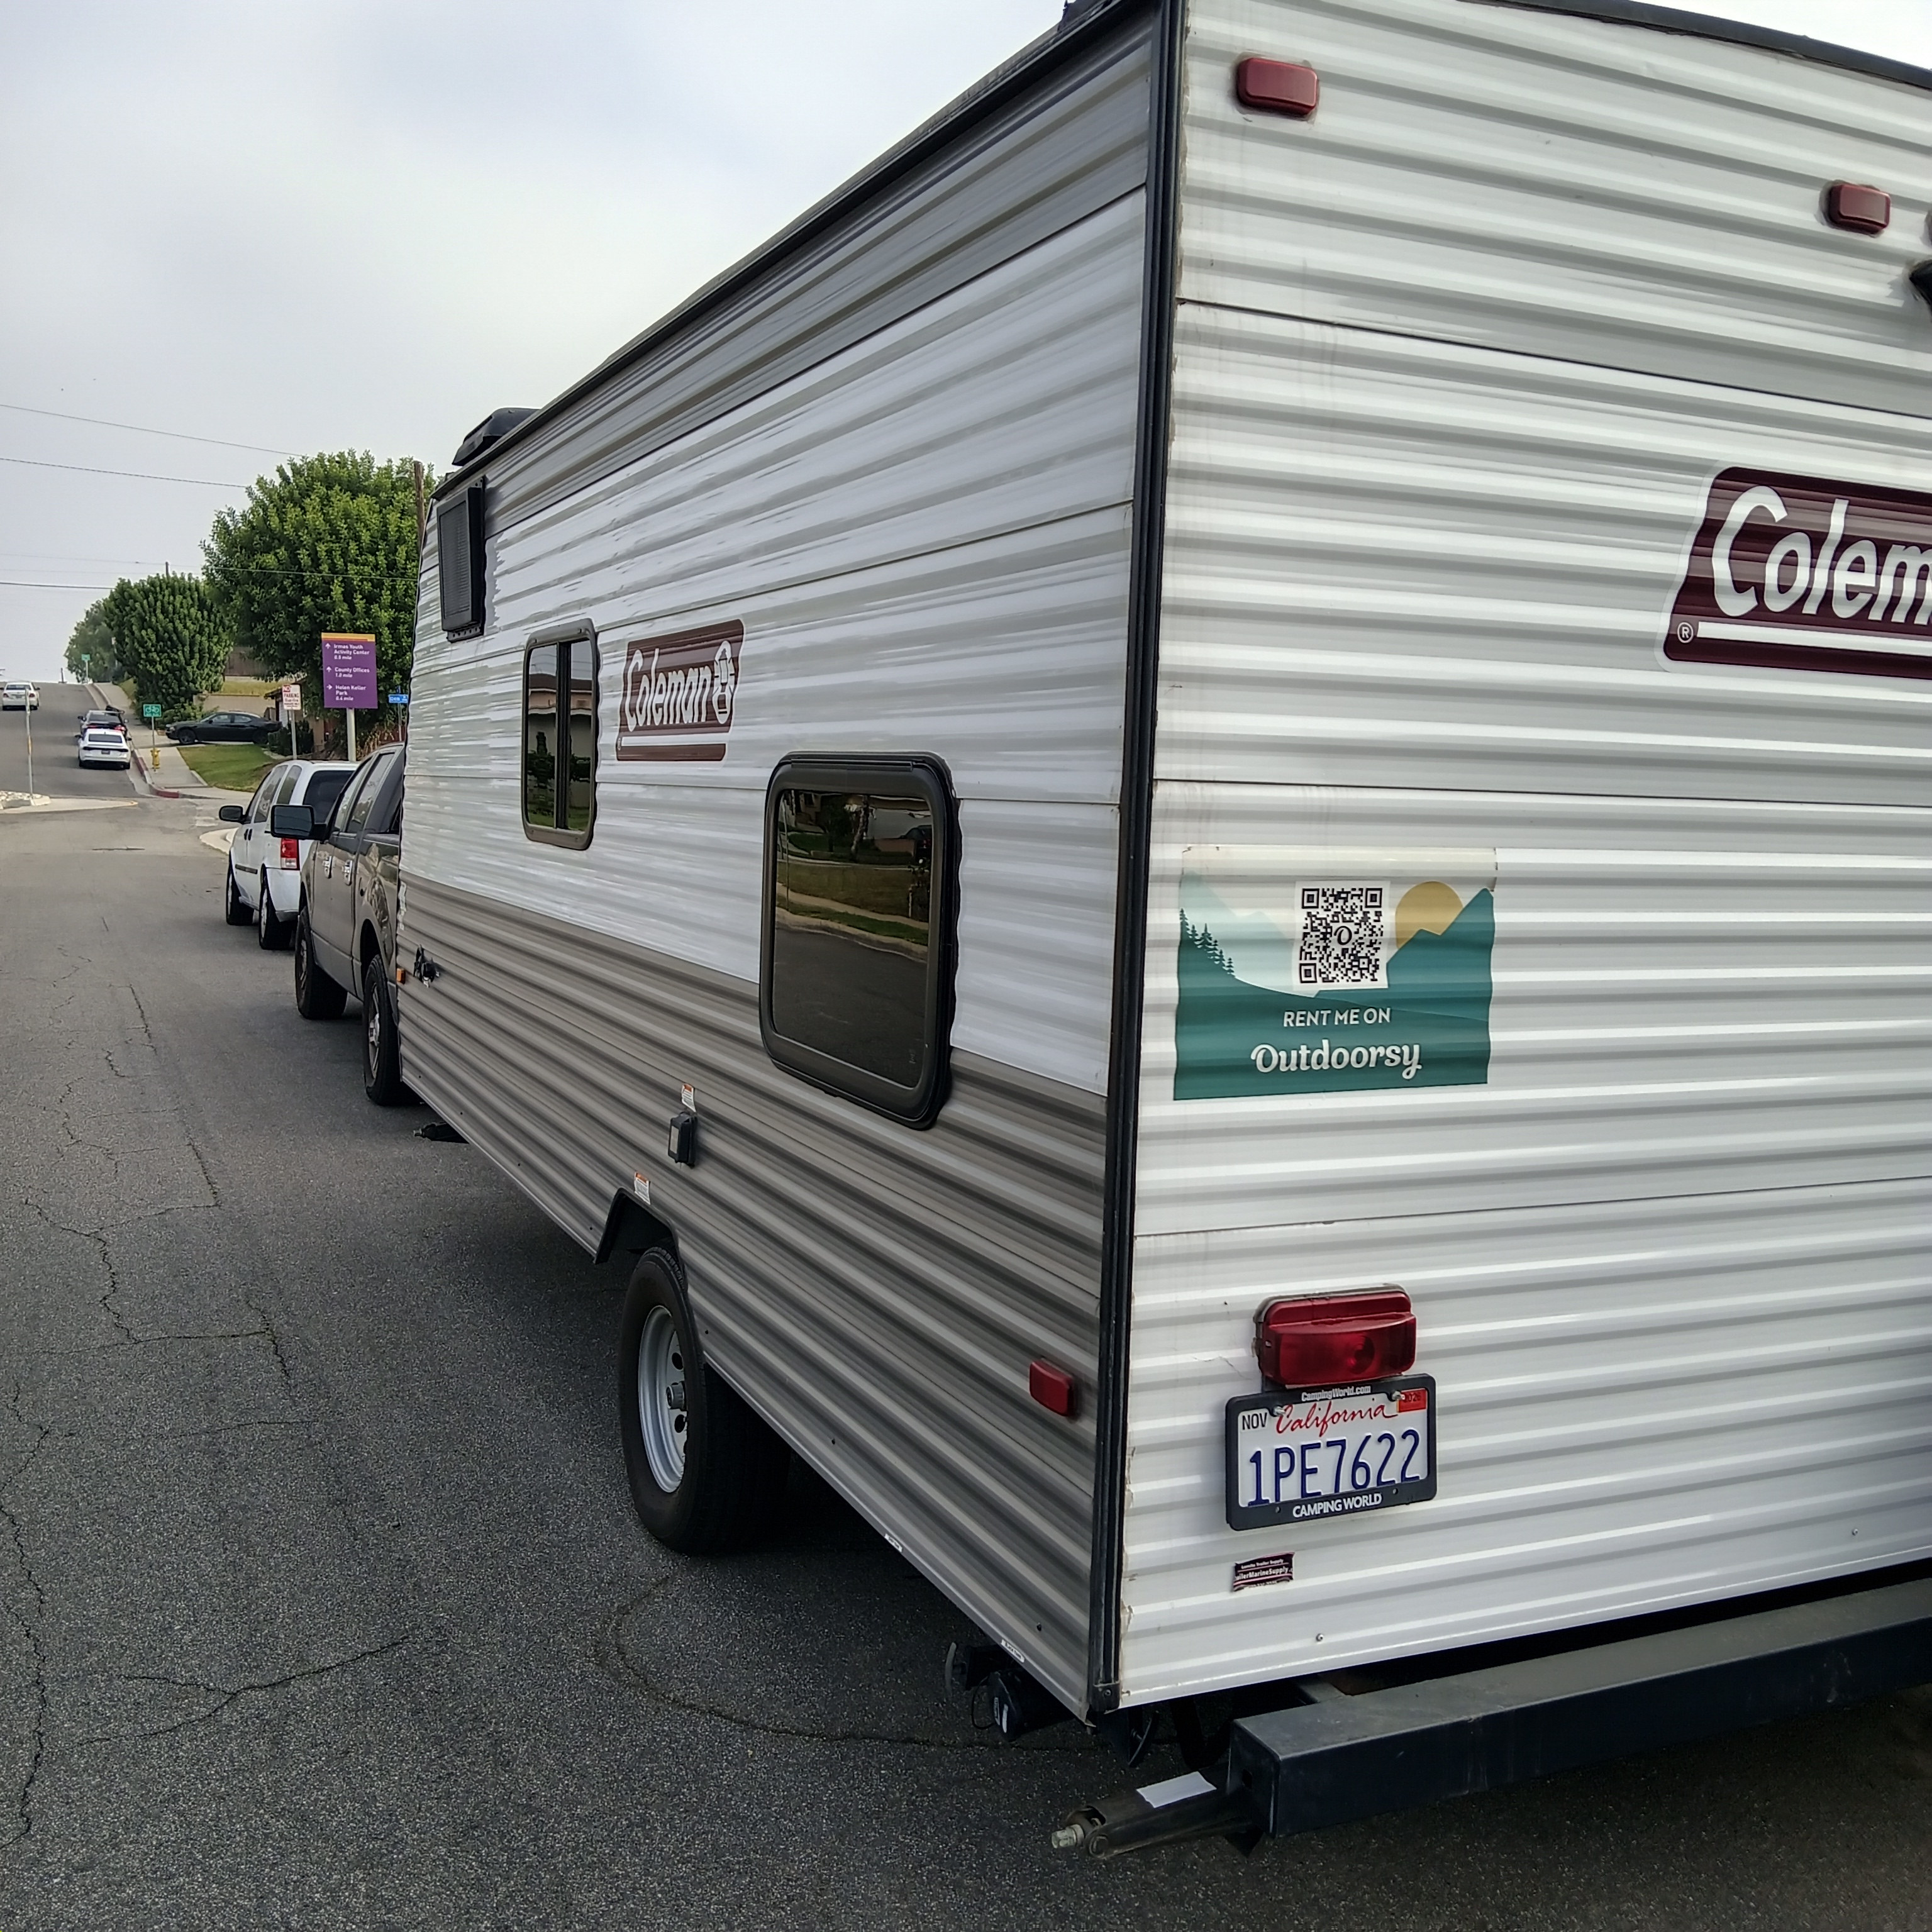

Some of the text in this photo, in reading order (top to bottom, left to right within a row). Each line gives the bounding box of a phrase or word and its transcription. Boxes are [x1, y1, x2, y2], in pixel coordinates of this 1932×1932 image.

[625, 648, 712, 732] Coleman
[1284, 1008, 1391, 1027] RENT ME ON
[1250, 1039, 1422, 1079] Outdoorsy
[1301, 1385, 1371, 1402] CampingWorld.com
[1241, 1413, 1267, 1431] NOV
[1275, 1400, 1398, 1438] California
[1248, 1429, 1419, 1507] 1PE7622
[1292, 1492, 1382, 1518] CAMPING WORLD
